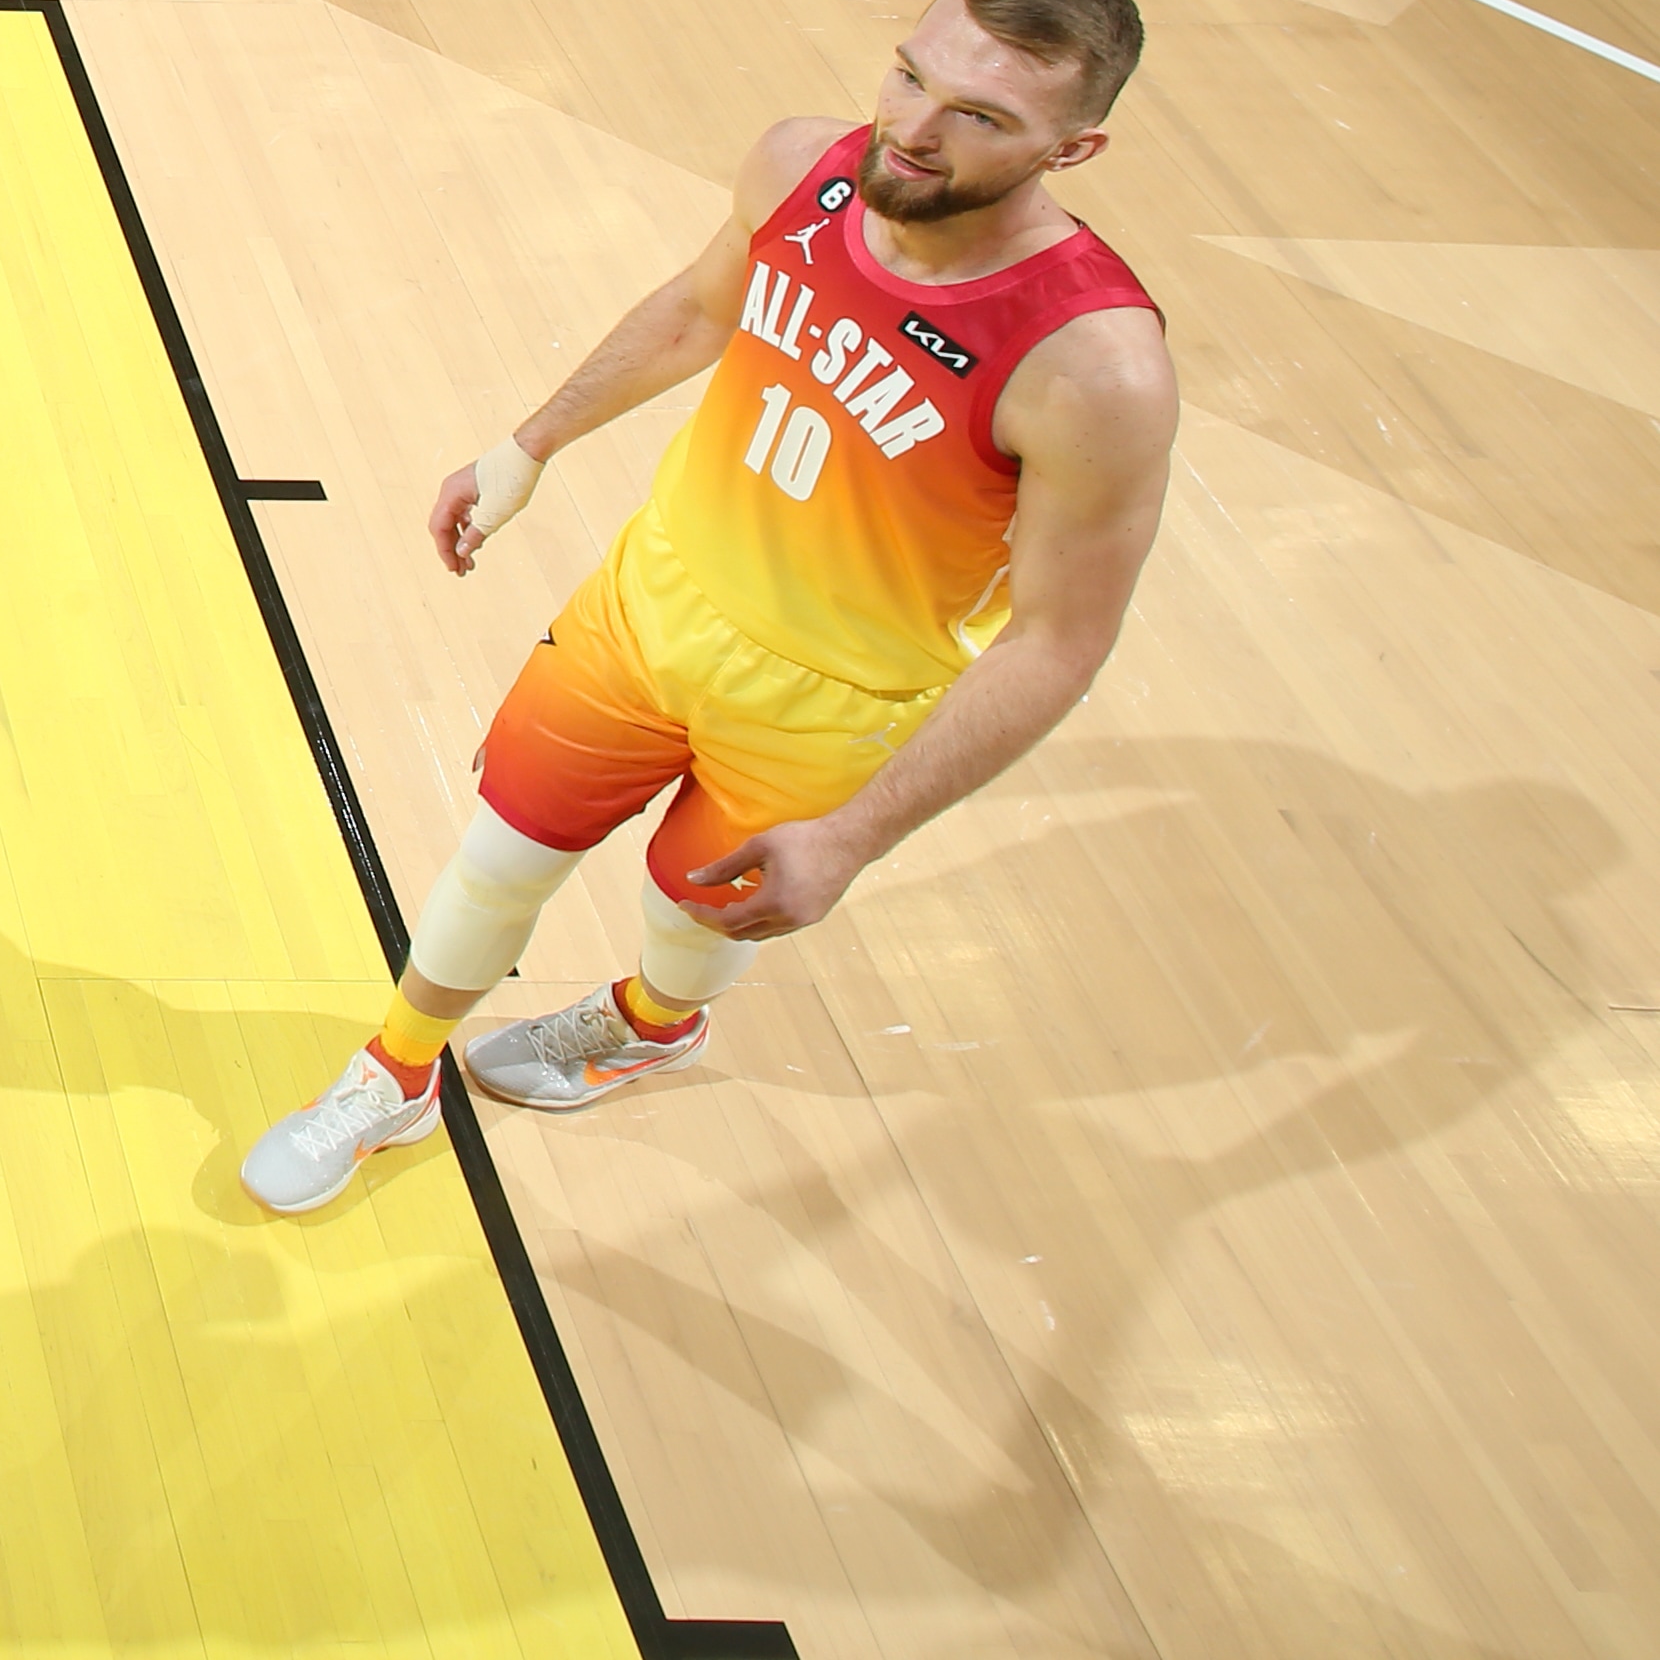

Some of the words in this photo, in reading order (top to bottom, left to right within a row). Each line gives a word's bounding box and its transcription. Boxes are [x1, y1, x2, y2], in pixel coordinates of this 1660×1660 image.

[820, 181, 852, 210] 6
[740, 260, 946, 460] ALL-STAR
[904, 319, 970, 369] KIA
[743, 383, 832, 503] 10
